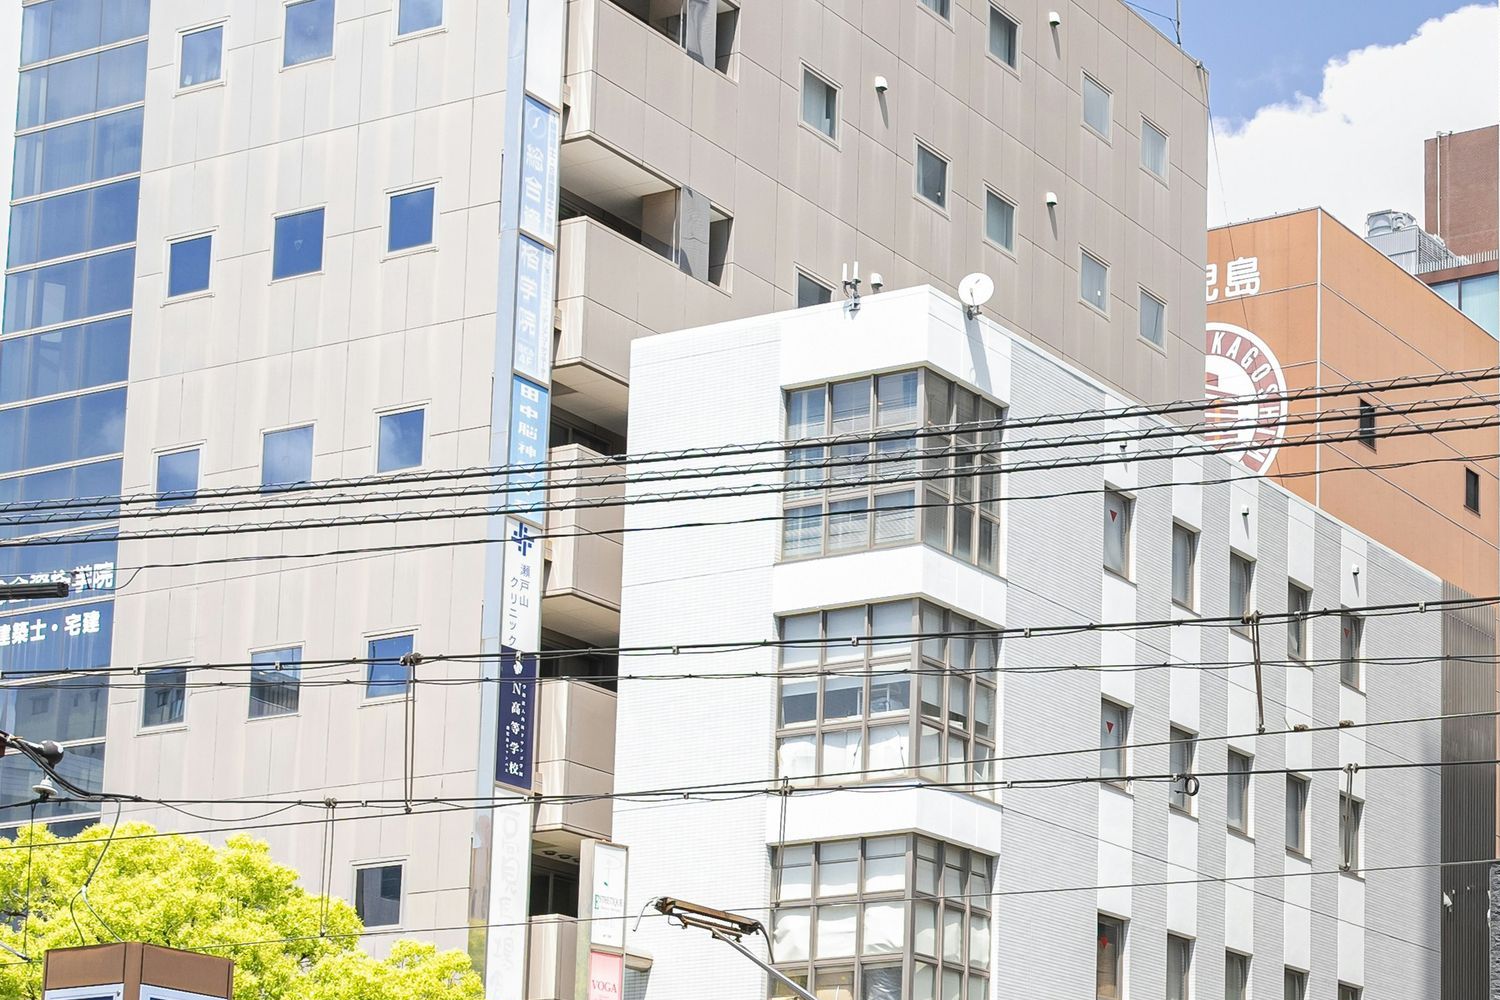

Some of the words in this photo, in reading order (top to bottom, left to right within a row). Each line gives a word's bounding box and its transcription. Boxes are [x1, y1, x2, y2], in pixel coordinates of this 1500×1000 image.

[508, 577, 519, 646] クリニック
[508, 682, 522, 776] N高等学校
[592, 979, 617, 993] VOGA
